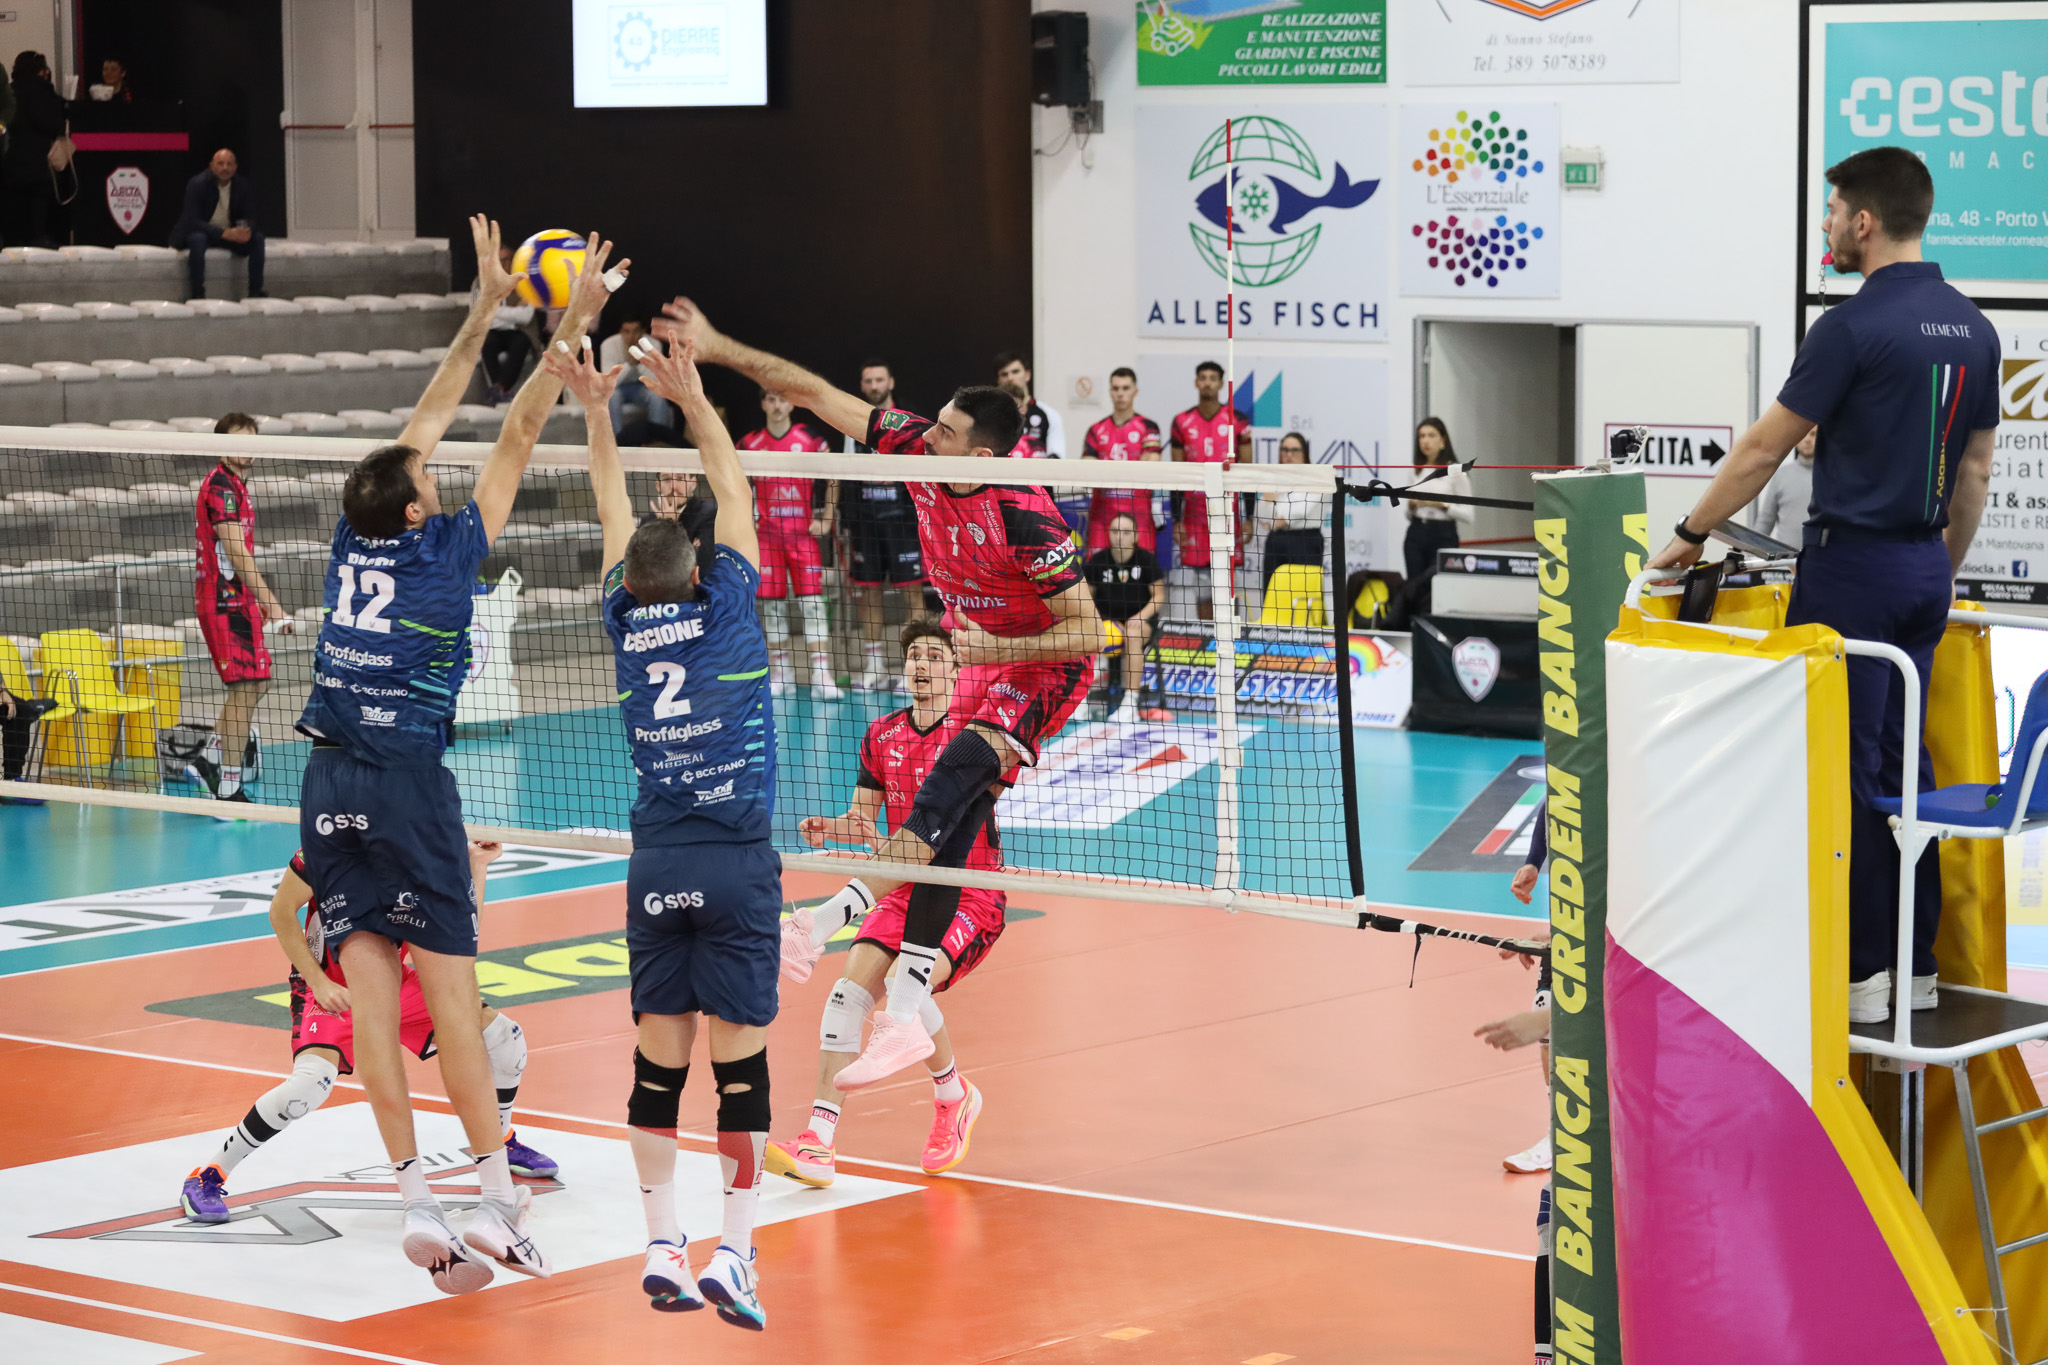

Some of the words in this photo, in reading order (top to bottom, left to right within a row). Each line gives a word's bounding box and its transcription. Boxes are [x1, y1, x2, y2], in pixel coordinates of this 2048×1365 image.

[1261, 12, 1382, 27] REALIZZAZIONE
[1247, 31, 1258, 43] E
[1259, 29, 1382, 43] MANUTENZIONE
[1549, 32, 1593, 48] Stefano
[1234, 47, 1304, 60] GIARDINI
[1307, 47, 1318, 59] E
[1320, 45, 1382, 59] PISCINE
[1218, 64, 1279, 77] PICCOLI
[1281, 63, 1336, 76] LAVORI
[1338, 62, 1383, 75] EDILI
[1473, 56, 1495, 72] Tel.
[1504, 55, 1533, 72] 389
[1542, 54, 1607, 71] 5078389
[1426, 182, 1529, 205] L'Essenziale
[1959, 210, 1980, 227] 48
[1996, 210, 2038, 227] Porto
[1147, 300, 1252, 326] ALLES
[1274, 302, 1378, 328] FISCH
[1920, 322, 1972, 339] CLEMENTE
[2006, 491, 2019, 509] &
[2021, 516, 2030, 529] e
[331, 564, 396, 634] 12
[632, 603, 680, 621] FANO
[1533, 517, 1579, 738] BANCA
[324, 641, 394, 667] Profilglass
[381, 689, 409, 697] FANO
[645, 661, 692, 721] 2
[635, 717, 723, 744] Profilglass
[695, 768, 717, 779] BCC
[717, 758, 746, 774] FANO
[1546, 763, 1588, 1015] CREDEM
[308, 1021, 318, 1034] 4
[813, 1109, 837, 1124] DELTA
[1554, 1056, 1594, 1277] BANCA
